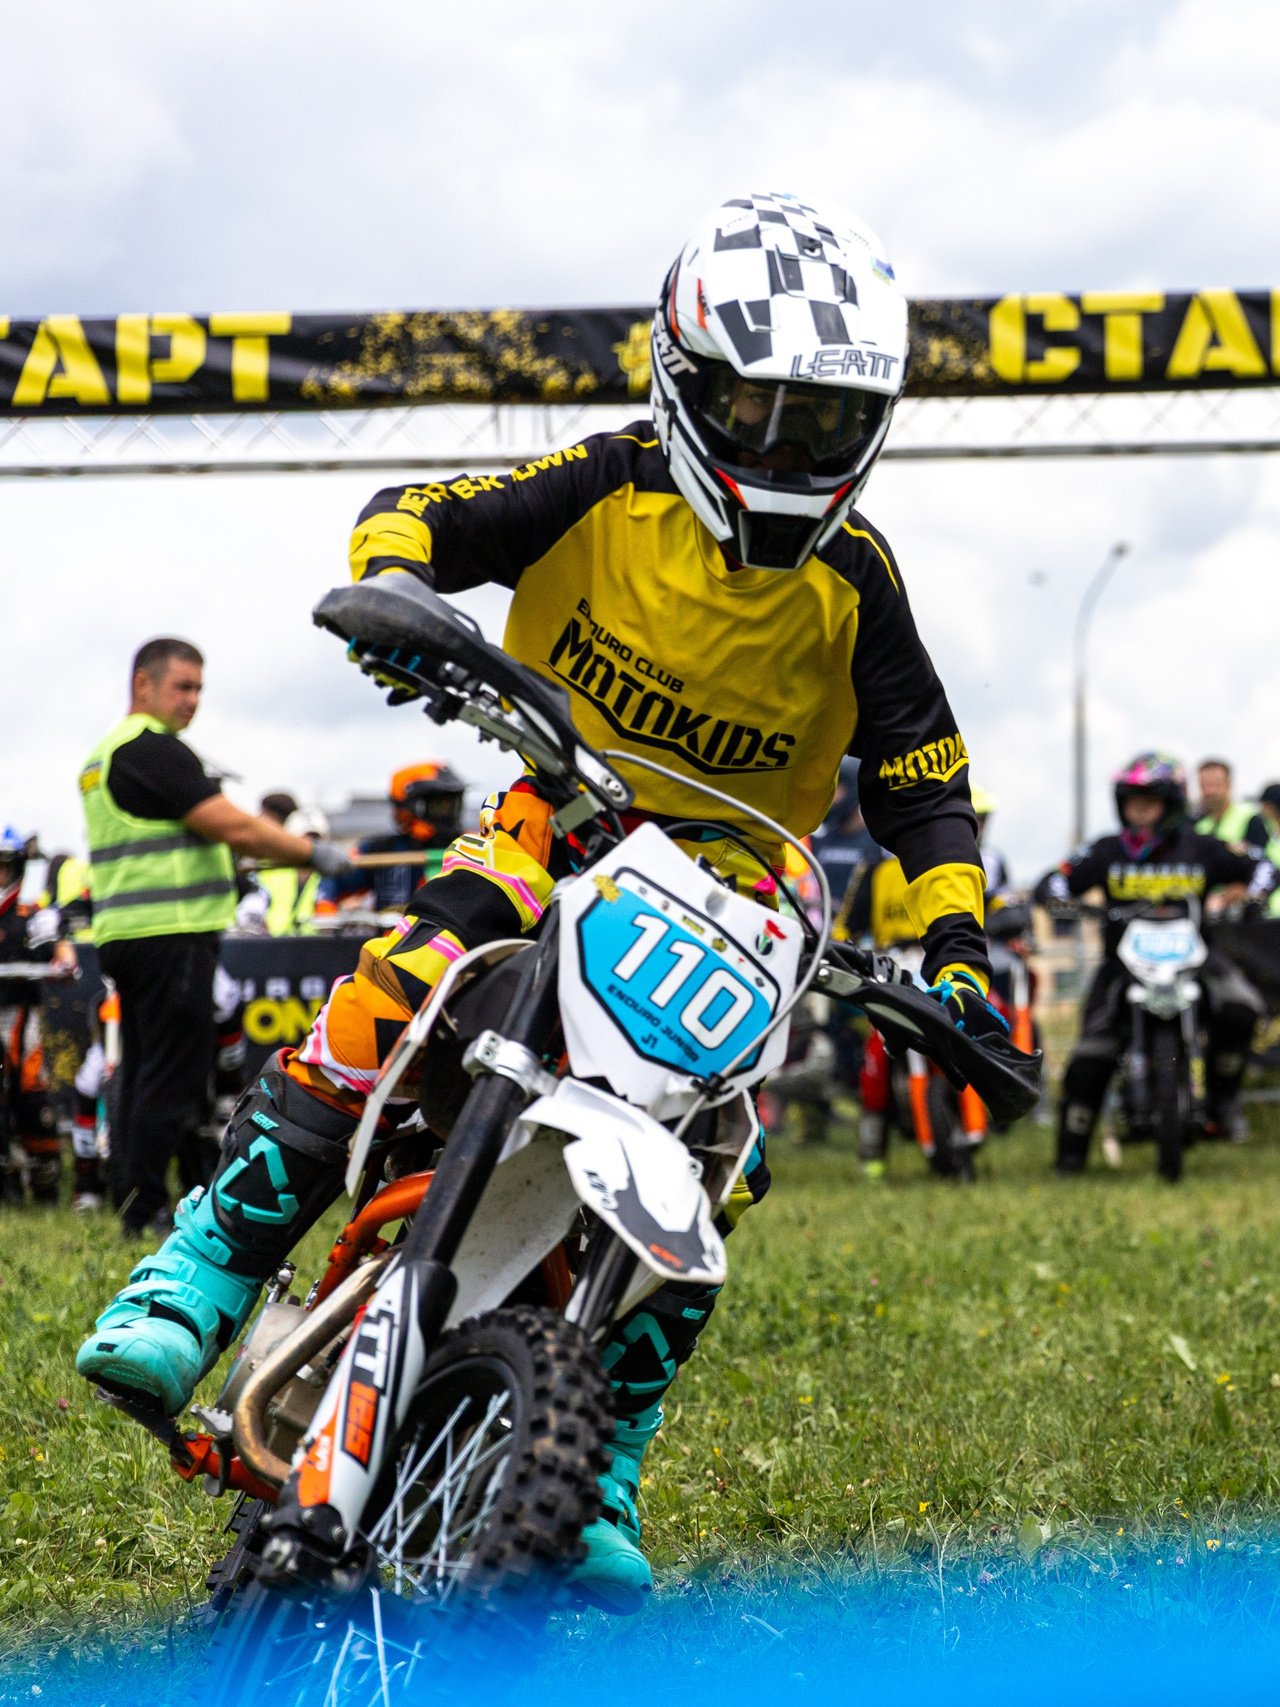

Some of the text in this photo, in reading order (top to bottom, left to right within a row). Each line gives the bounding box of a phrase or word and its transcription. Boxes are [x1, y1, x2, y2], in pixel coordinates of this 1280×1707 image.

[0, 311, 292, 407] АРТ
[790, 349, 899, 379] LEATT
[548, 617, 796, 768] MOTOKIDS
[634, 656, 685, 694] CLUB
[612, 911, 755, 1051] 110
[606, 983, 661, 1028] ENDURO
[641, 1033, 659, 1050] J1
